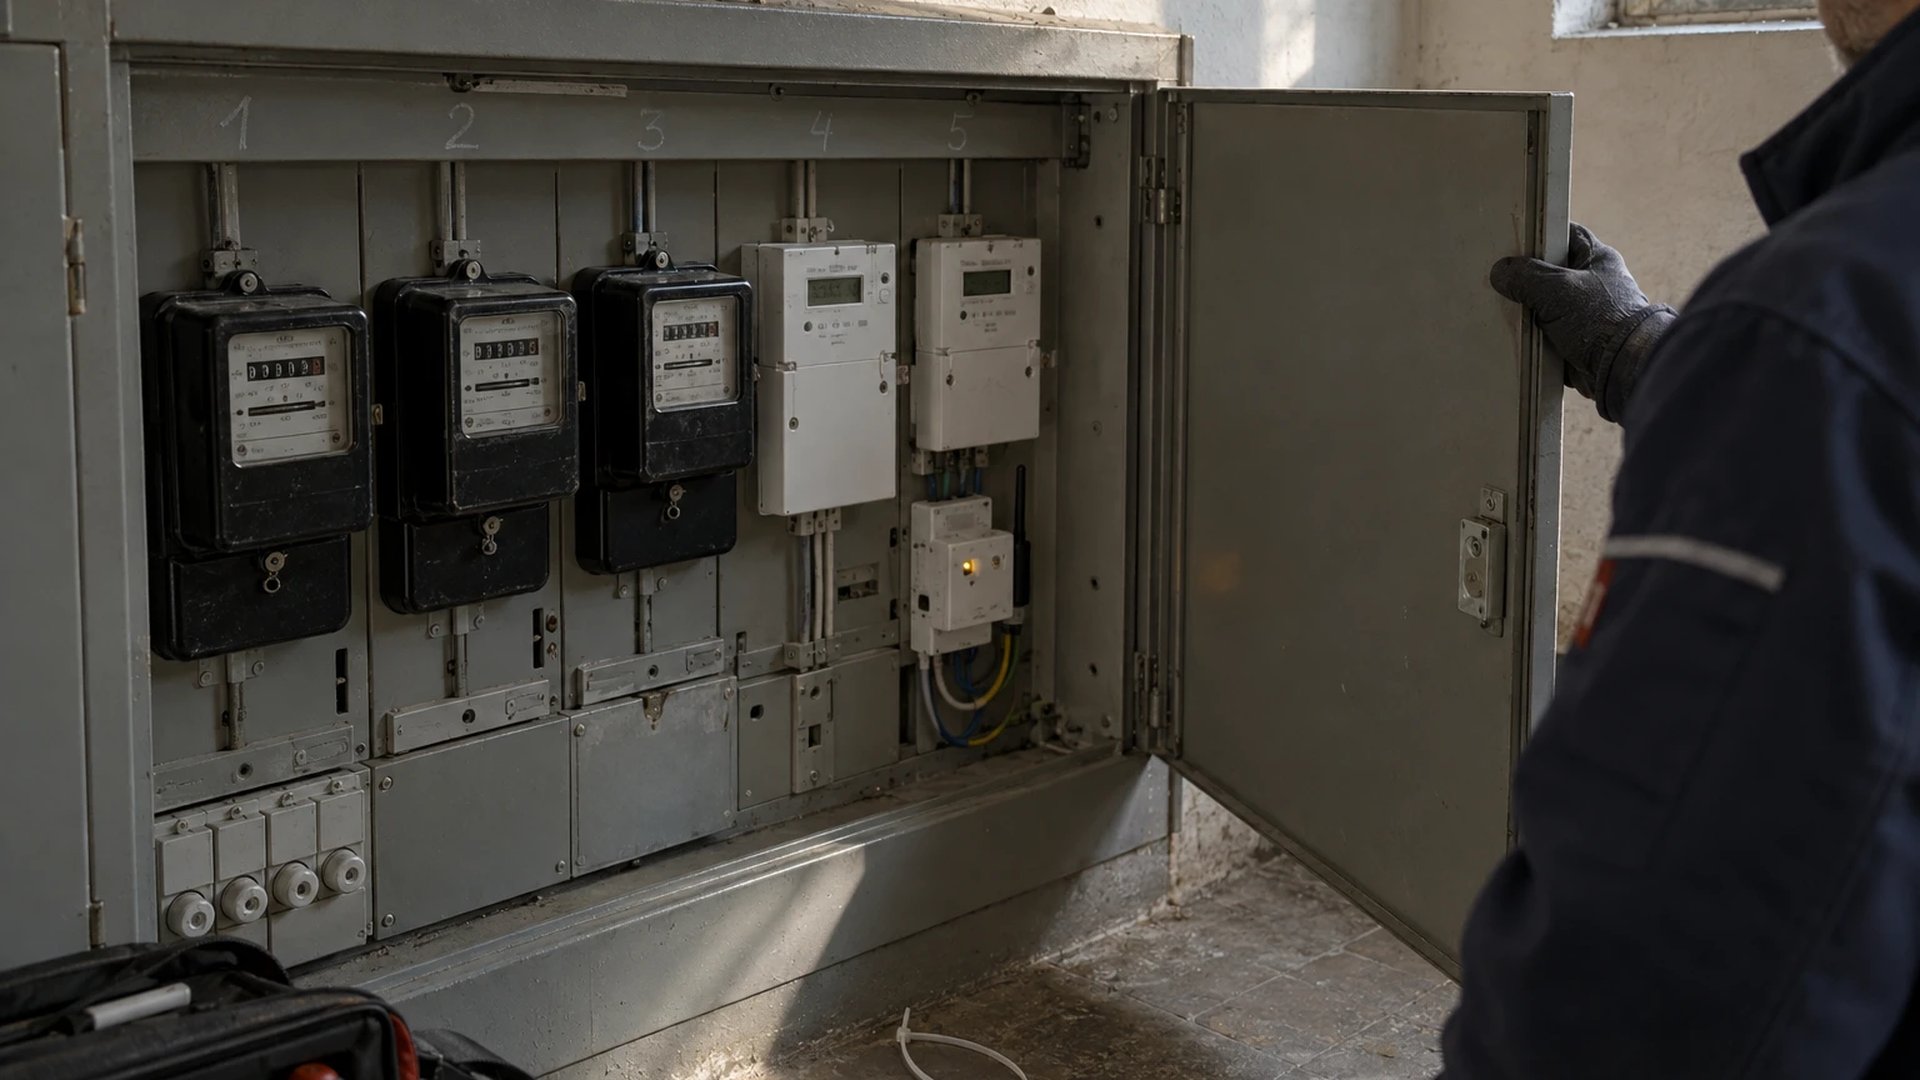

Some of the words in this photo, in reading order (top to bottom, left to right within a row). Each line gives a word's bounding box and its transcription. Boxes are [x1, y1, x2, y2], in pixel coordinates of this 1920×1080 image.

[219, 95, 252, 151] 1
[446, 102, 479, 150] 2
[638, 108, 664, 151] 3
[810, 110, 833, 152] 4
[948, 111, 974, 151] 5
